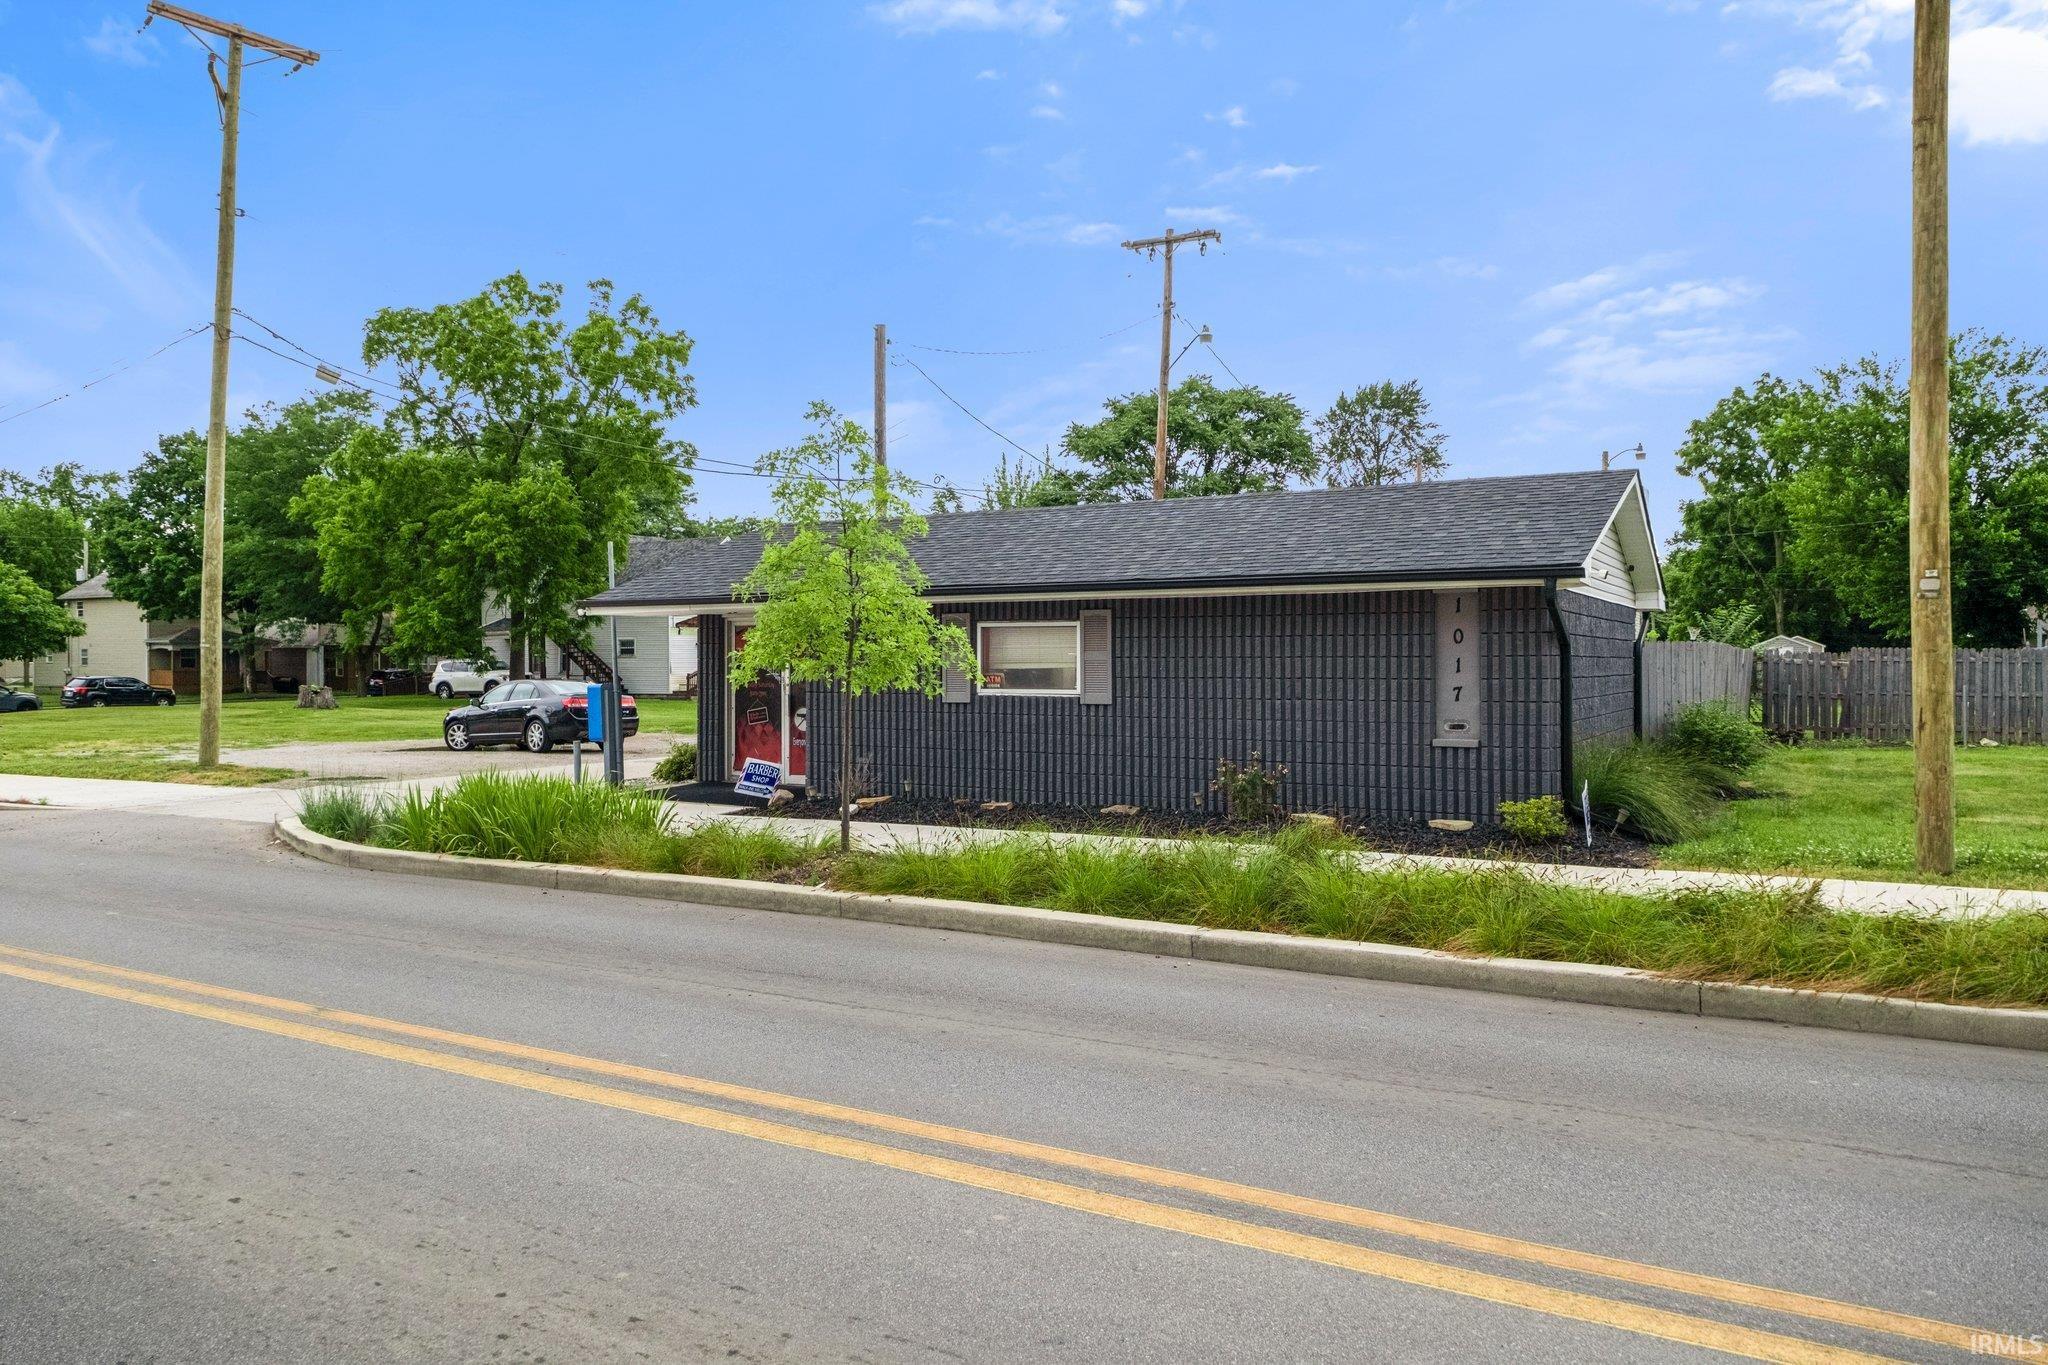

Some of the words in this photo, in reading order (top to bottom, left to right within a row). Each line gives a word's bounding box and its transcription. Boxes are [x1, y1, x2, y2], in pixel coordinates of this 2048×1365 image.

[1453, 597, 1464, 702] 1017
[986, 675, 1001, 683] ATM
[747, 763, 779, 779] BARBER
[751, 775, 769, 783] SHOP
